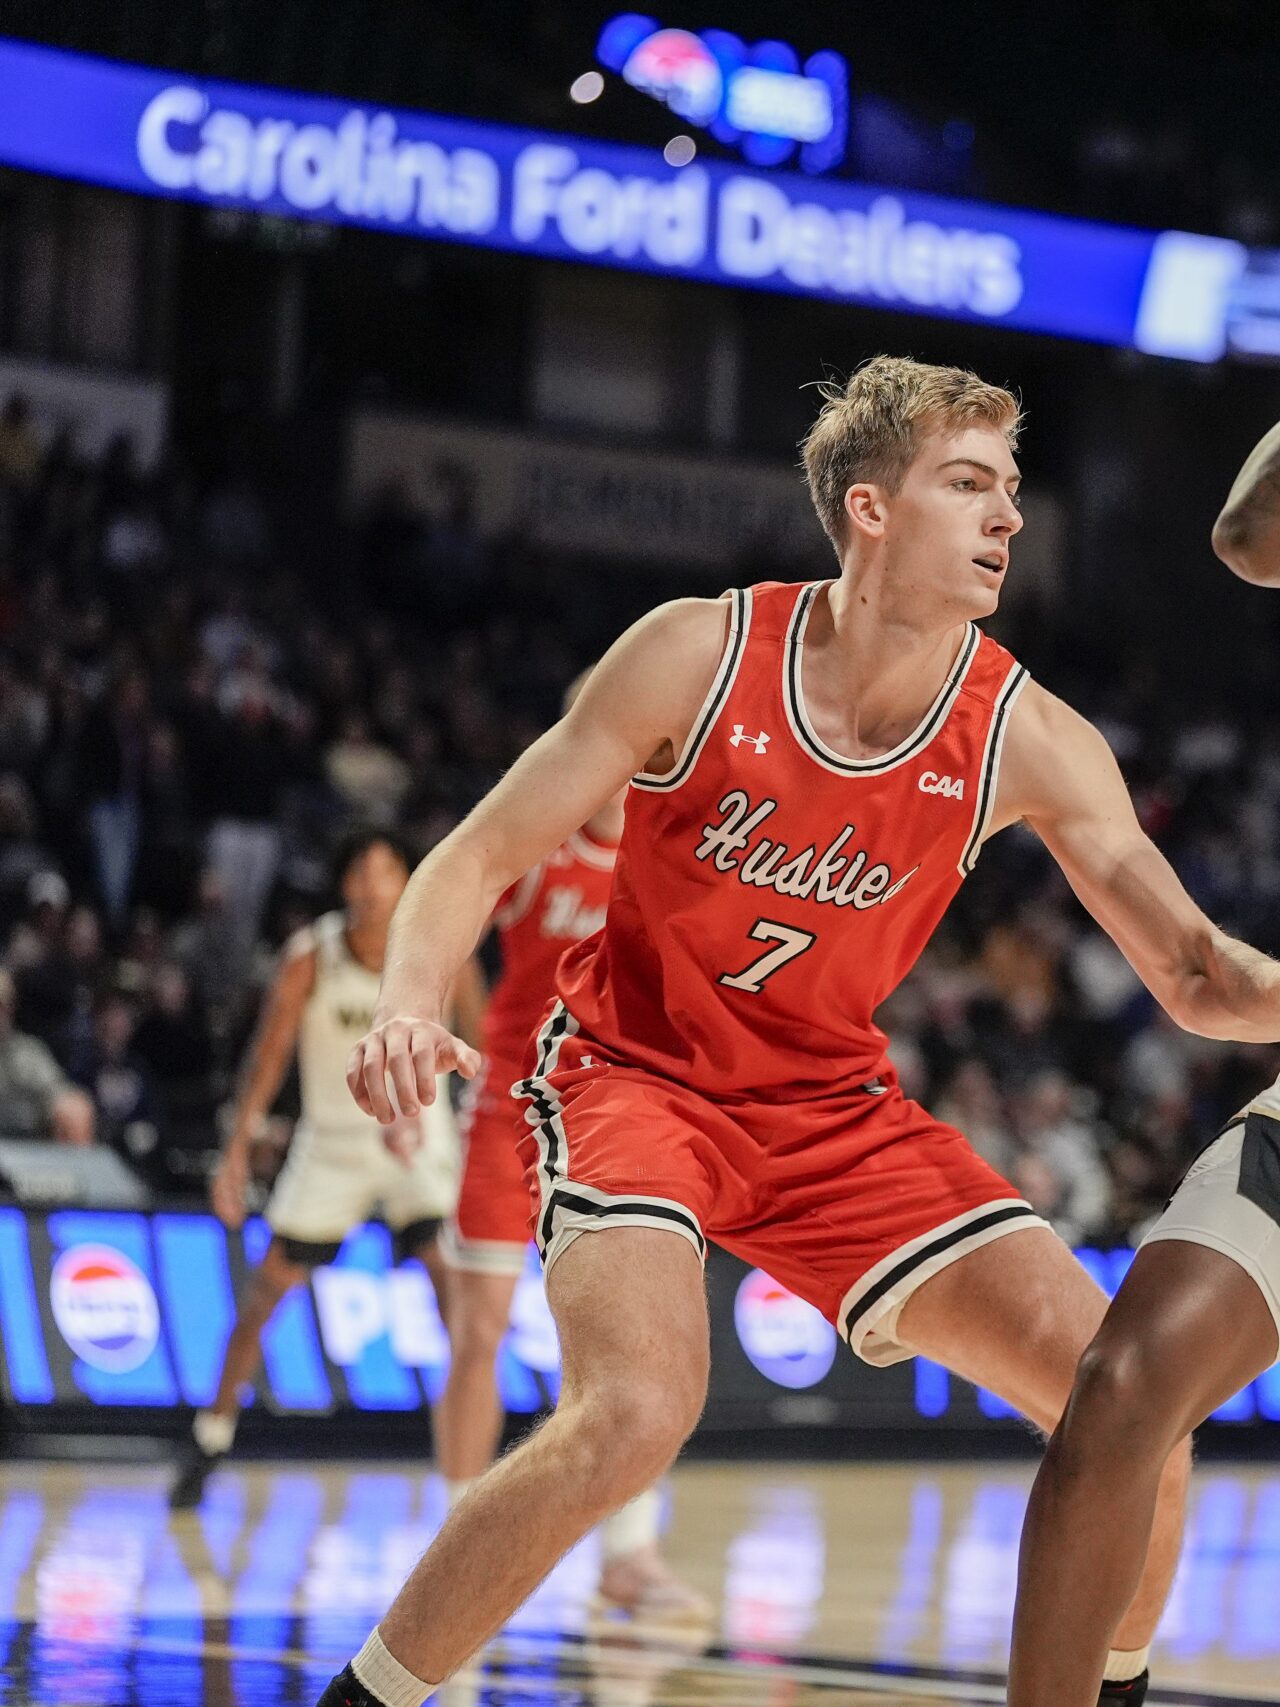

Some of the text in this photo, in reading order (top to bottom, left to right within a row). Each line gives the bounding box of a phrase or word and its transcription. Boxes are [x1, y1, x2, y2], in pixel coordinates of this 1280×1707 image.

[137, 85, 1023, 317] Carolina Ford Dealers
[918, 770, 965, 800] CAA
[716, 917, 817, 994] 7
